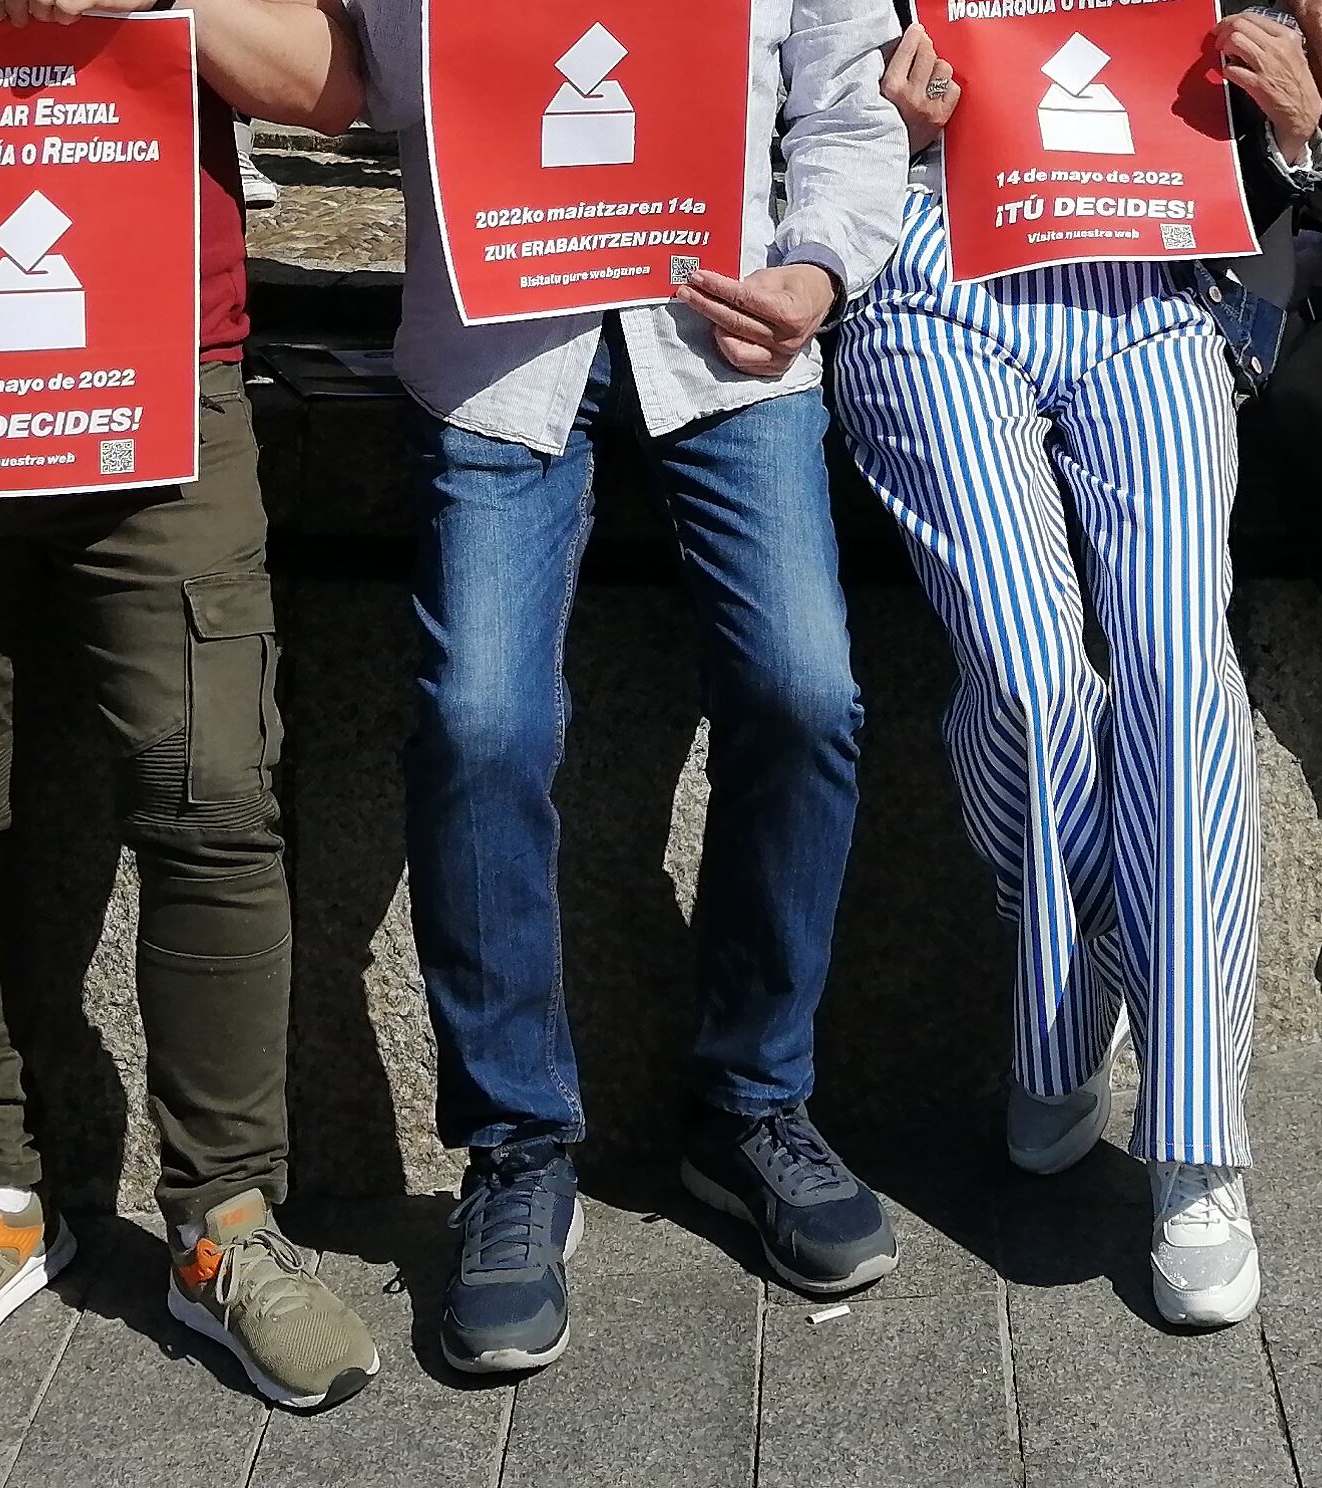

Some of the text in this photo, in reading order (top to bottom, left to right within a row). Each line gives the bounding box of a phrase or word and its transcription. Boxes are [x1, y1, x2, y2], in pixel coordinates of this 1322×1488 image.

[34, 98, 119, 125] ESTATAL
[42, 136, 159, 164] REPÚBLICA
[997, 168, 1183, 188] 14 de mayo de 2022
[476, 198, 705, 228] 2022ko maiatzaren 14a
[996, 194, 1195, 227] ¡TÚ DECIDES!
[485, 242, 518, 261] ZUK
[48, 373, 75, 390] de
[78, 369, 135, 388] 2022
